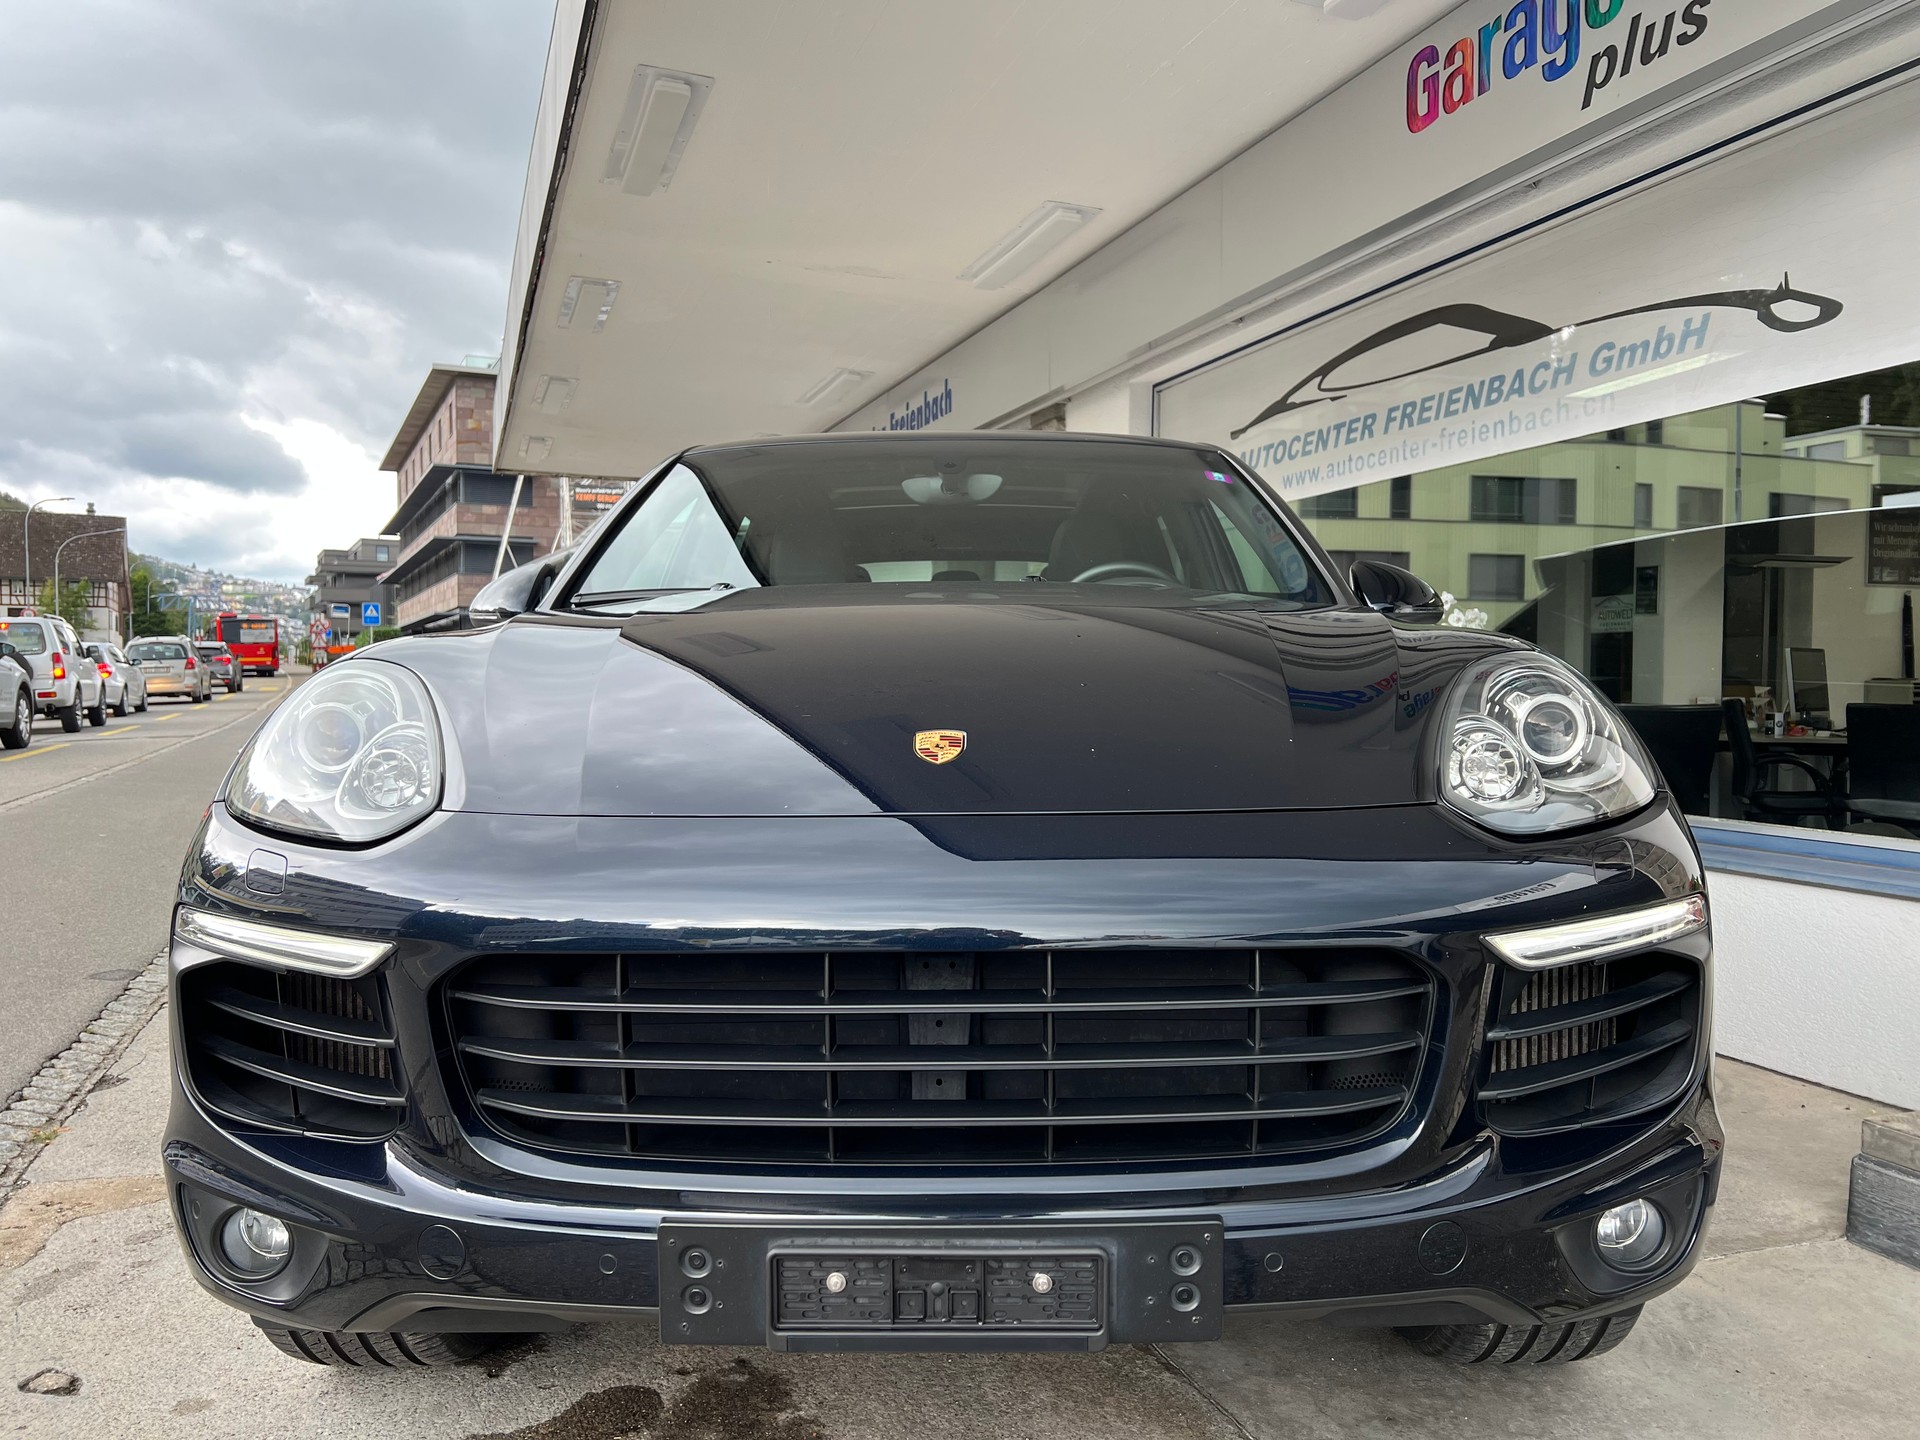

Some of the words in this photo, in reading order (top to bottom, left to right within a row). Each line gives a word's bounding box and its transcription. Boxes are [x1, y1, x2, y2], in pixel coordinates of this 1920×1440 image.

[1581, 0, 1710, 110] plus
[1239, 412, 1377, 471] AUTOCENTER
[1383, 352, 1578, 435] FREIENBACH
[1588, 311, 1712, 378] GmbH
